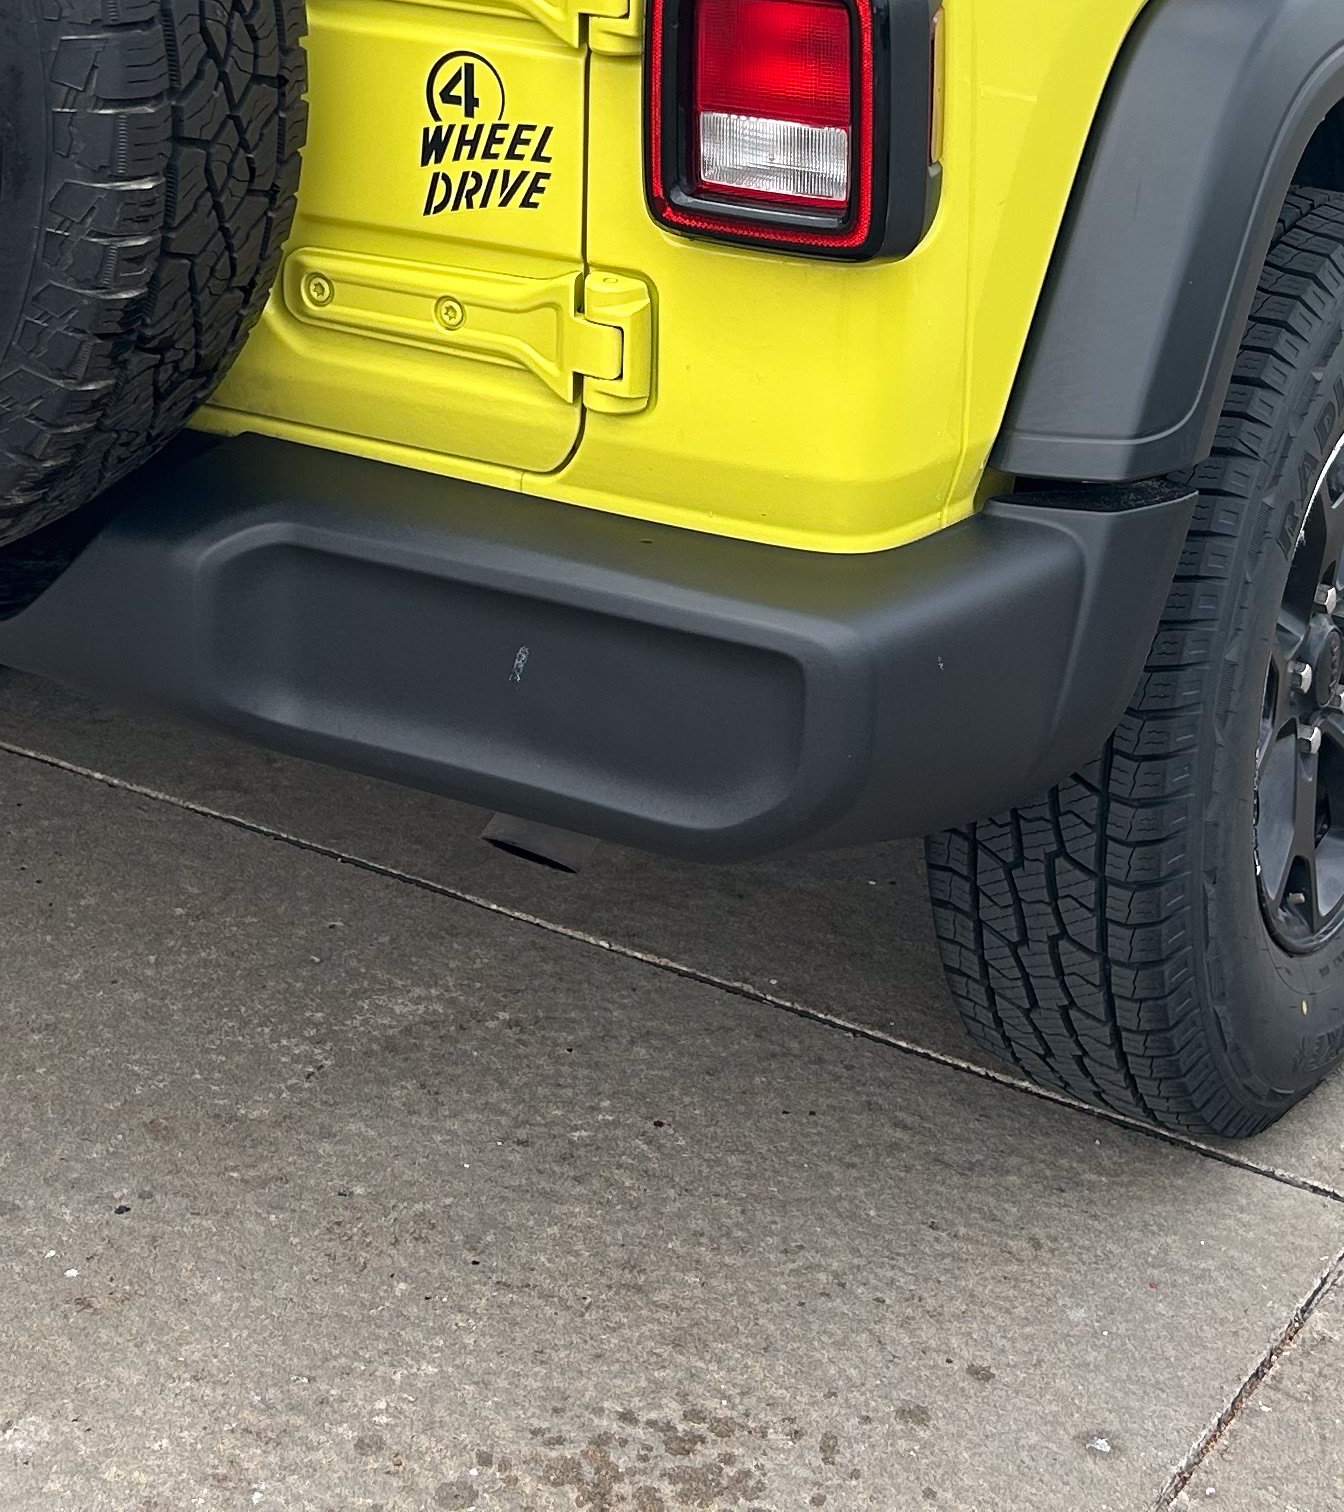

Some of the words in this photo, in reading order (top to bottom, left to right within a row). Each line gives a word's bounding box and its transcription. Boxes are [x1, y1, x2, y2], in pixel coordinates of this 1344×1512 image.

[439, 62, 480, 119] 4
[420, 122, 554, 168] WHEEL
[422, 169, 552, 217] DRIVE
